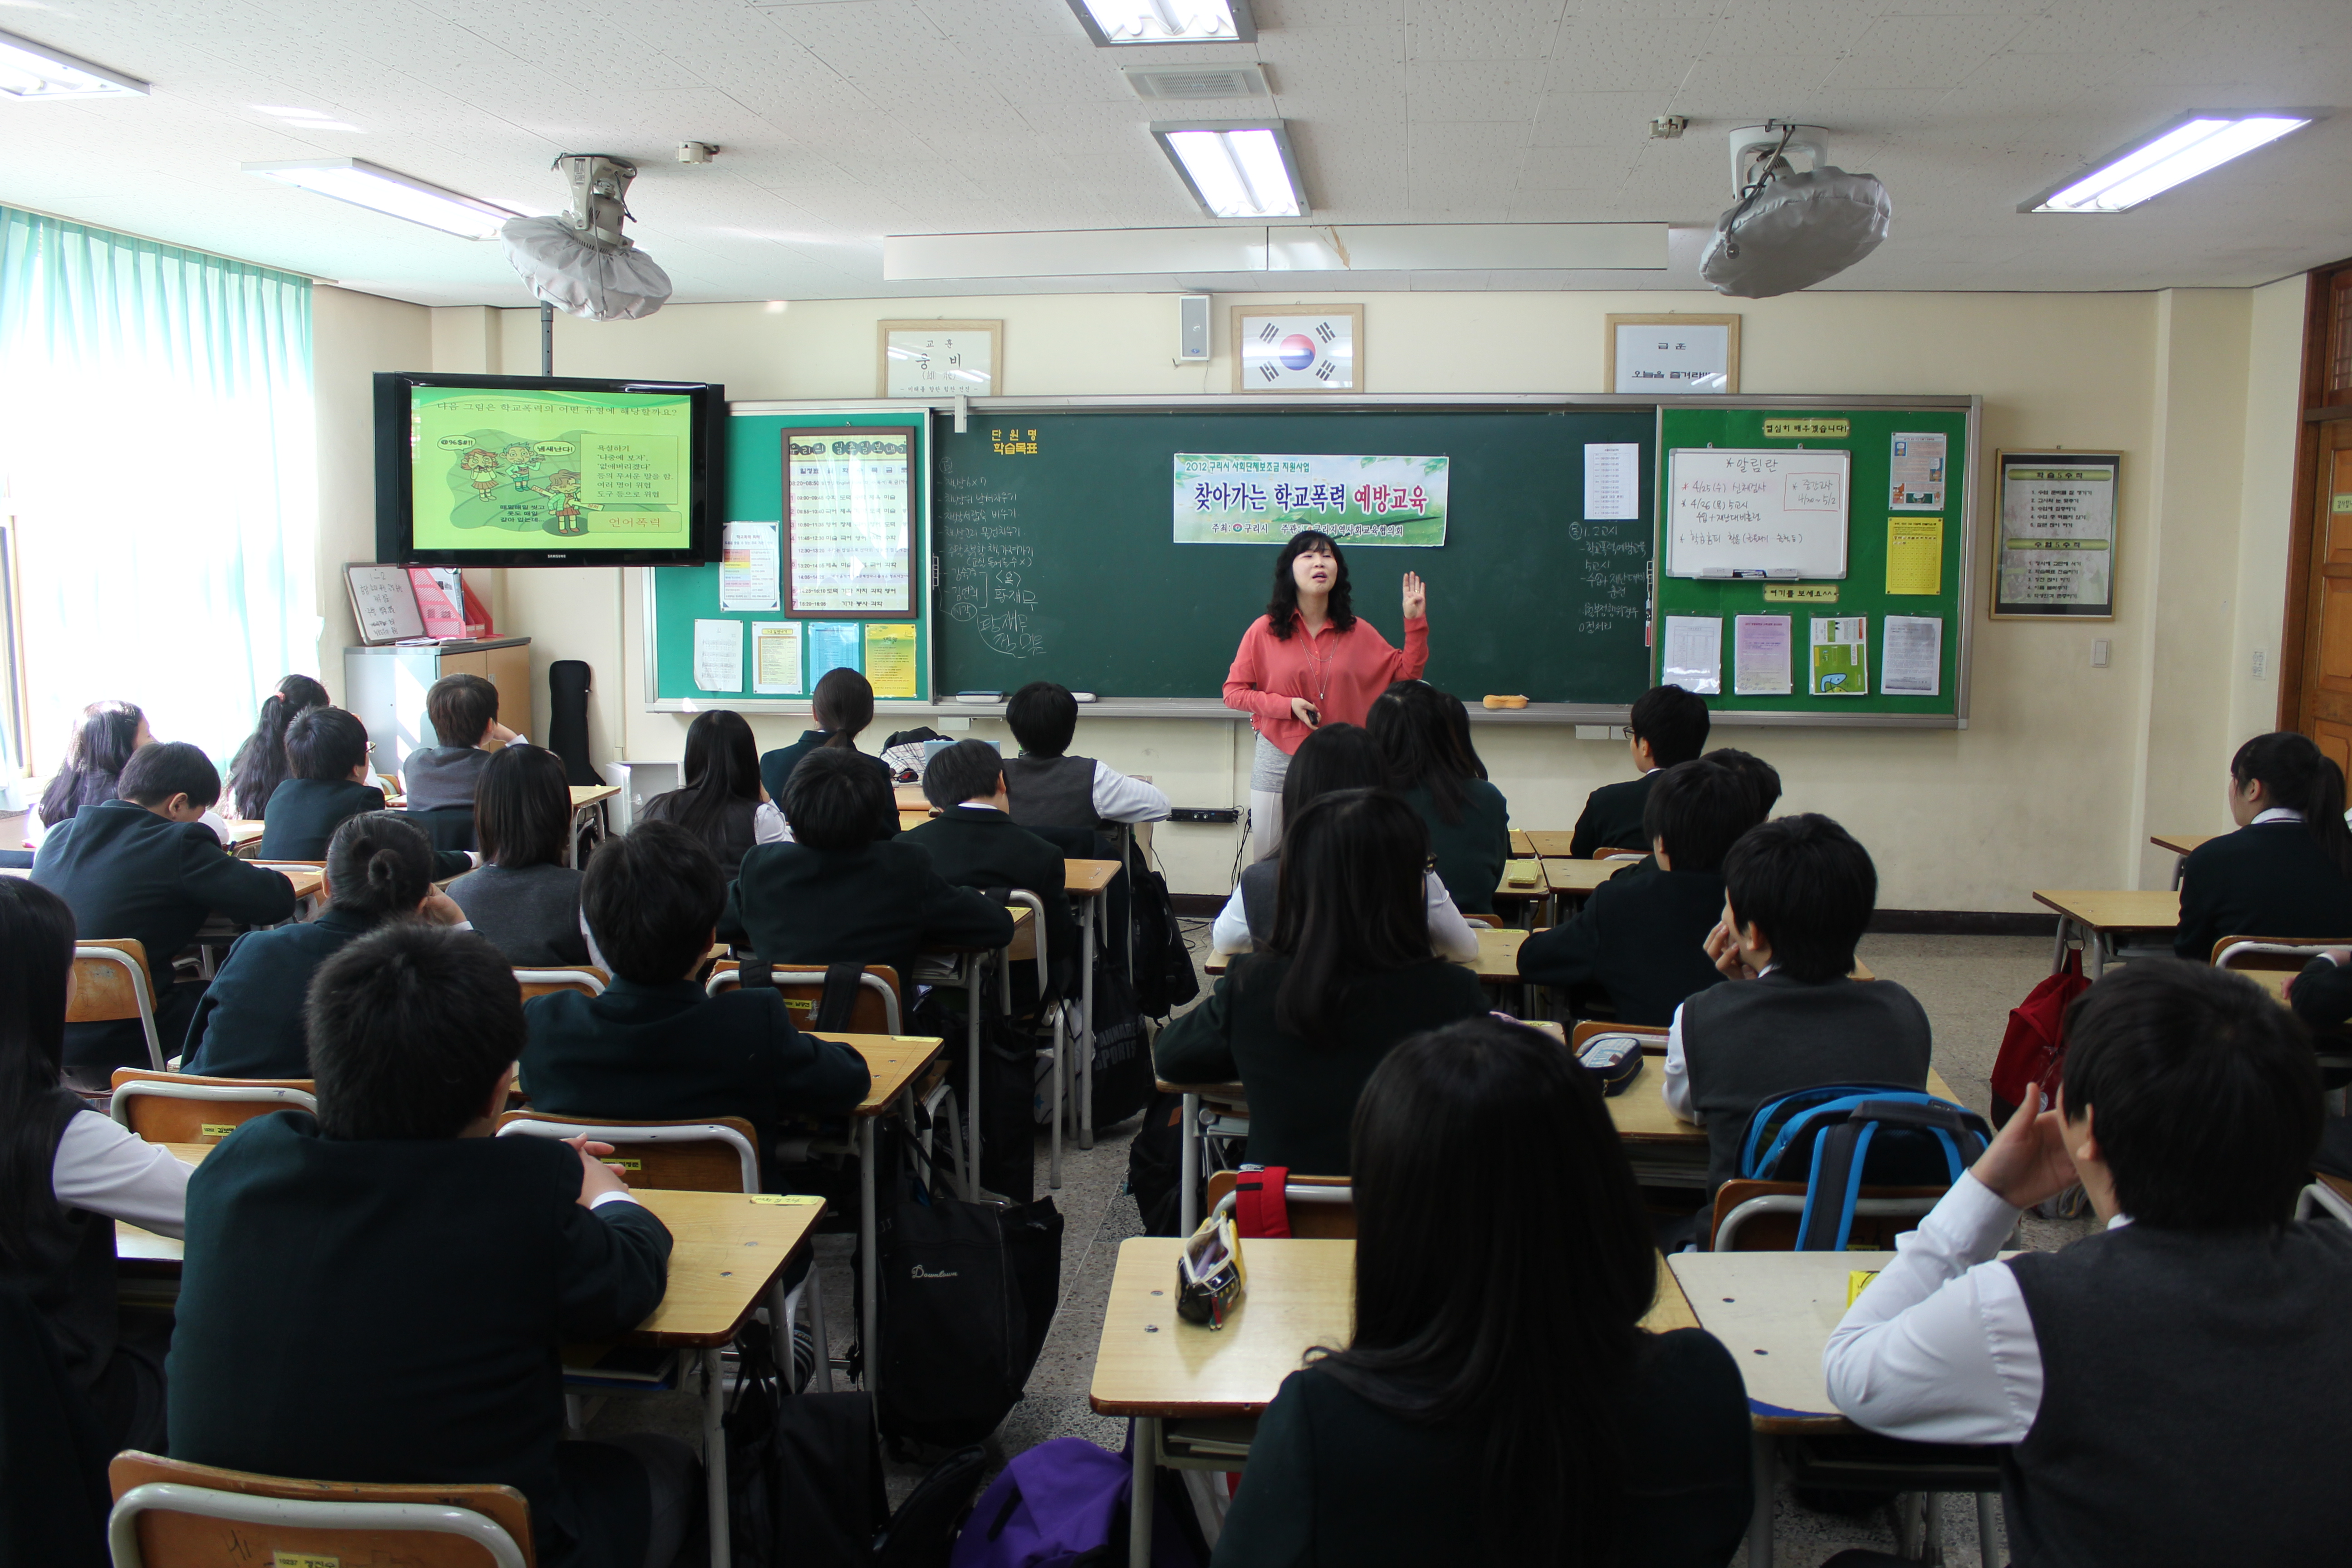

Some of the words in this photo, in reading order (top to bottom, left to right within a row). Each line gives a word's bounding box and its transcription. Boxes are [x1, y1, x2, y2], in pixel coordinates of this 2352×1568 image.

[437, 402, 459, 411] 다음
[463, 403, 495, 412] 그림은
[501, 404, 553, 413] 학교폭력의
[559, 405, 579, 414] 어떤
[584, 406, 614, 415] 유형에
[621, 407, 677, 416] 해당할까요?
[1766, 425, 1789, 433] 열심히
[1794, 424, 1847, 433] 배우겠습니다!
[789, 444, 824, 454] 우리의
[993, 442, 1038, 455] 학습목표
[1186, 462, 1207, 471] 2012
[1209, 462, 1230, 472] 구리시
[1232, 462, 1279, 472] 사회단체보조금
[1282, 462, 1309, 473] 지원사업
[1736, 458, 1778, 472] 알림란
[1195, 482, 1267, 511] 찾아가는
[1274, 483, 1345, 512] 학교폭력
[1354, 484, 1427, 514] 예방교육
[609, 517, 660, 528] 언어폭력
[1212, 523, 1231, 533] 주최:
[1244, 523, 1269, 534] 구리시
[1281, 524, 1301, 534] 주관:
[1314, 524, 1403, 536] 구리지역사회교육협의회
[911, 1264, 958, 1279] Downtown
